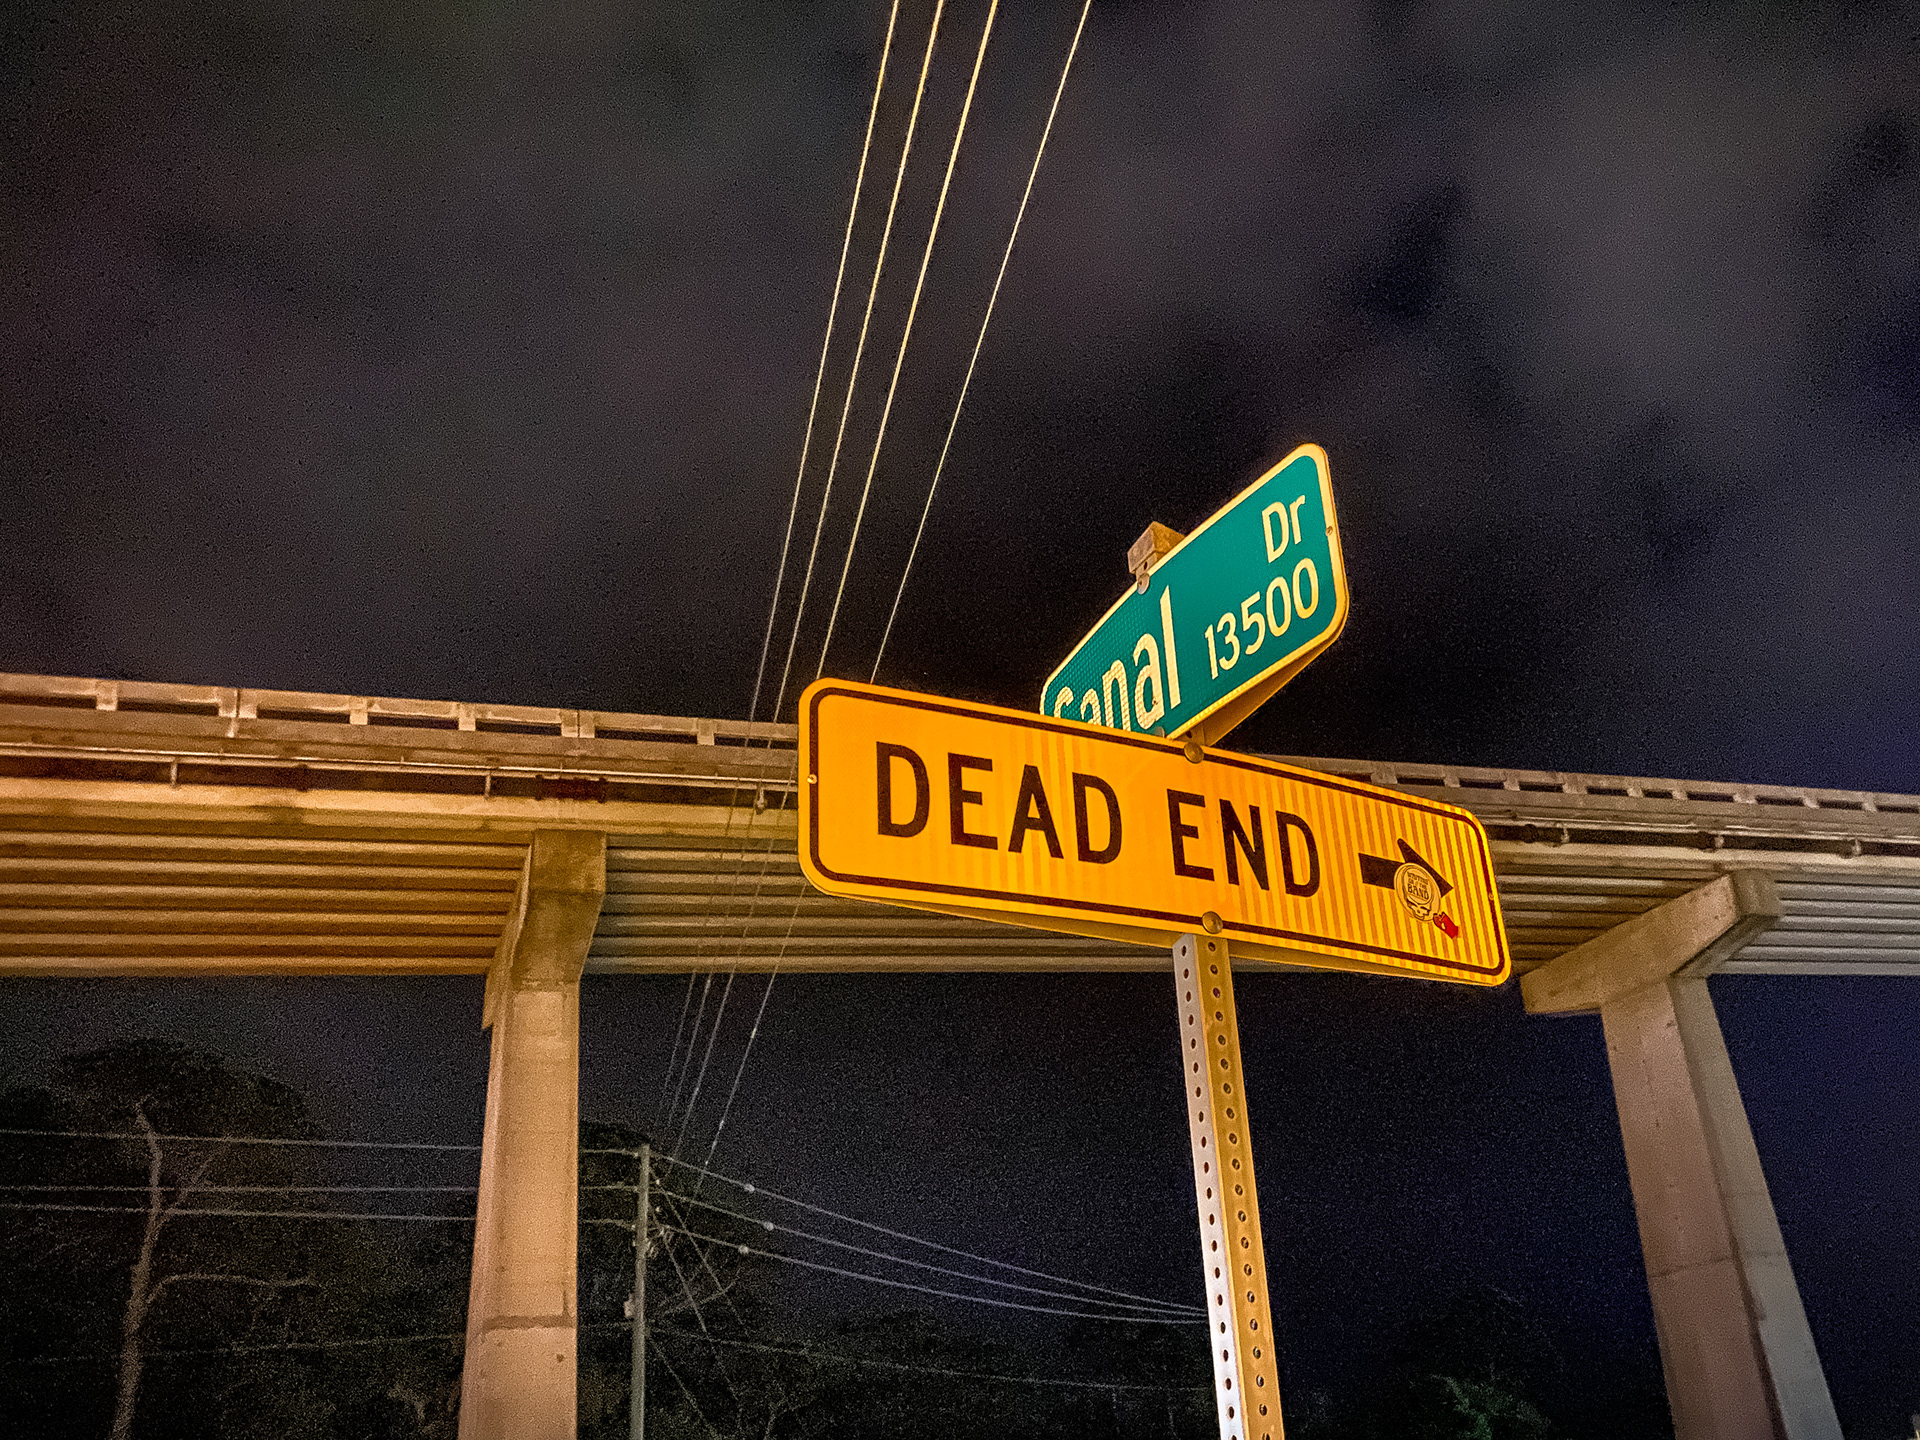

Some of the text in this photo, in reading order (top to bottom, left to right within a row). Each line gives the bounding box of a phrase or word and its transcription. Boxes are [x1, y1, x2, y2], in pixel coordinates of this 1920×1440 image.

[1262, 494, 1305, 563] Dr
[1204, 558, 1318, 680] 13500
[875, 741, 1321, 898] DEAD END
